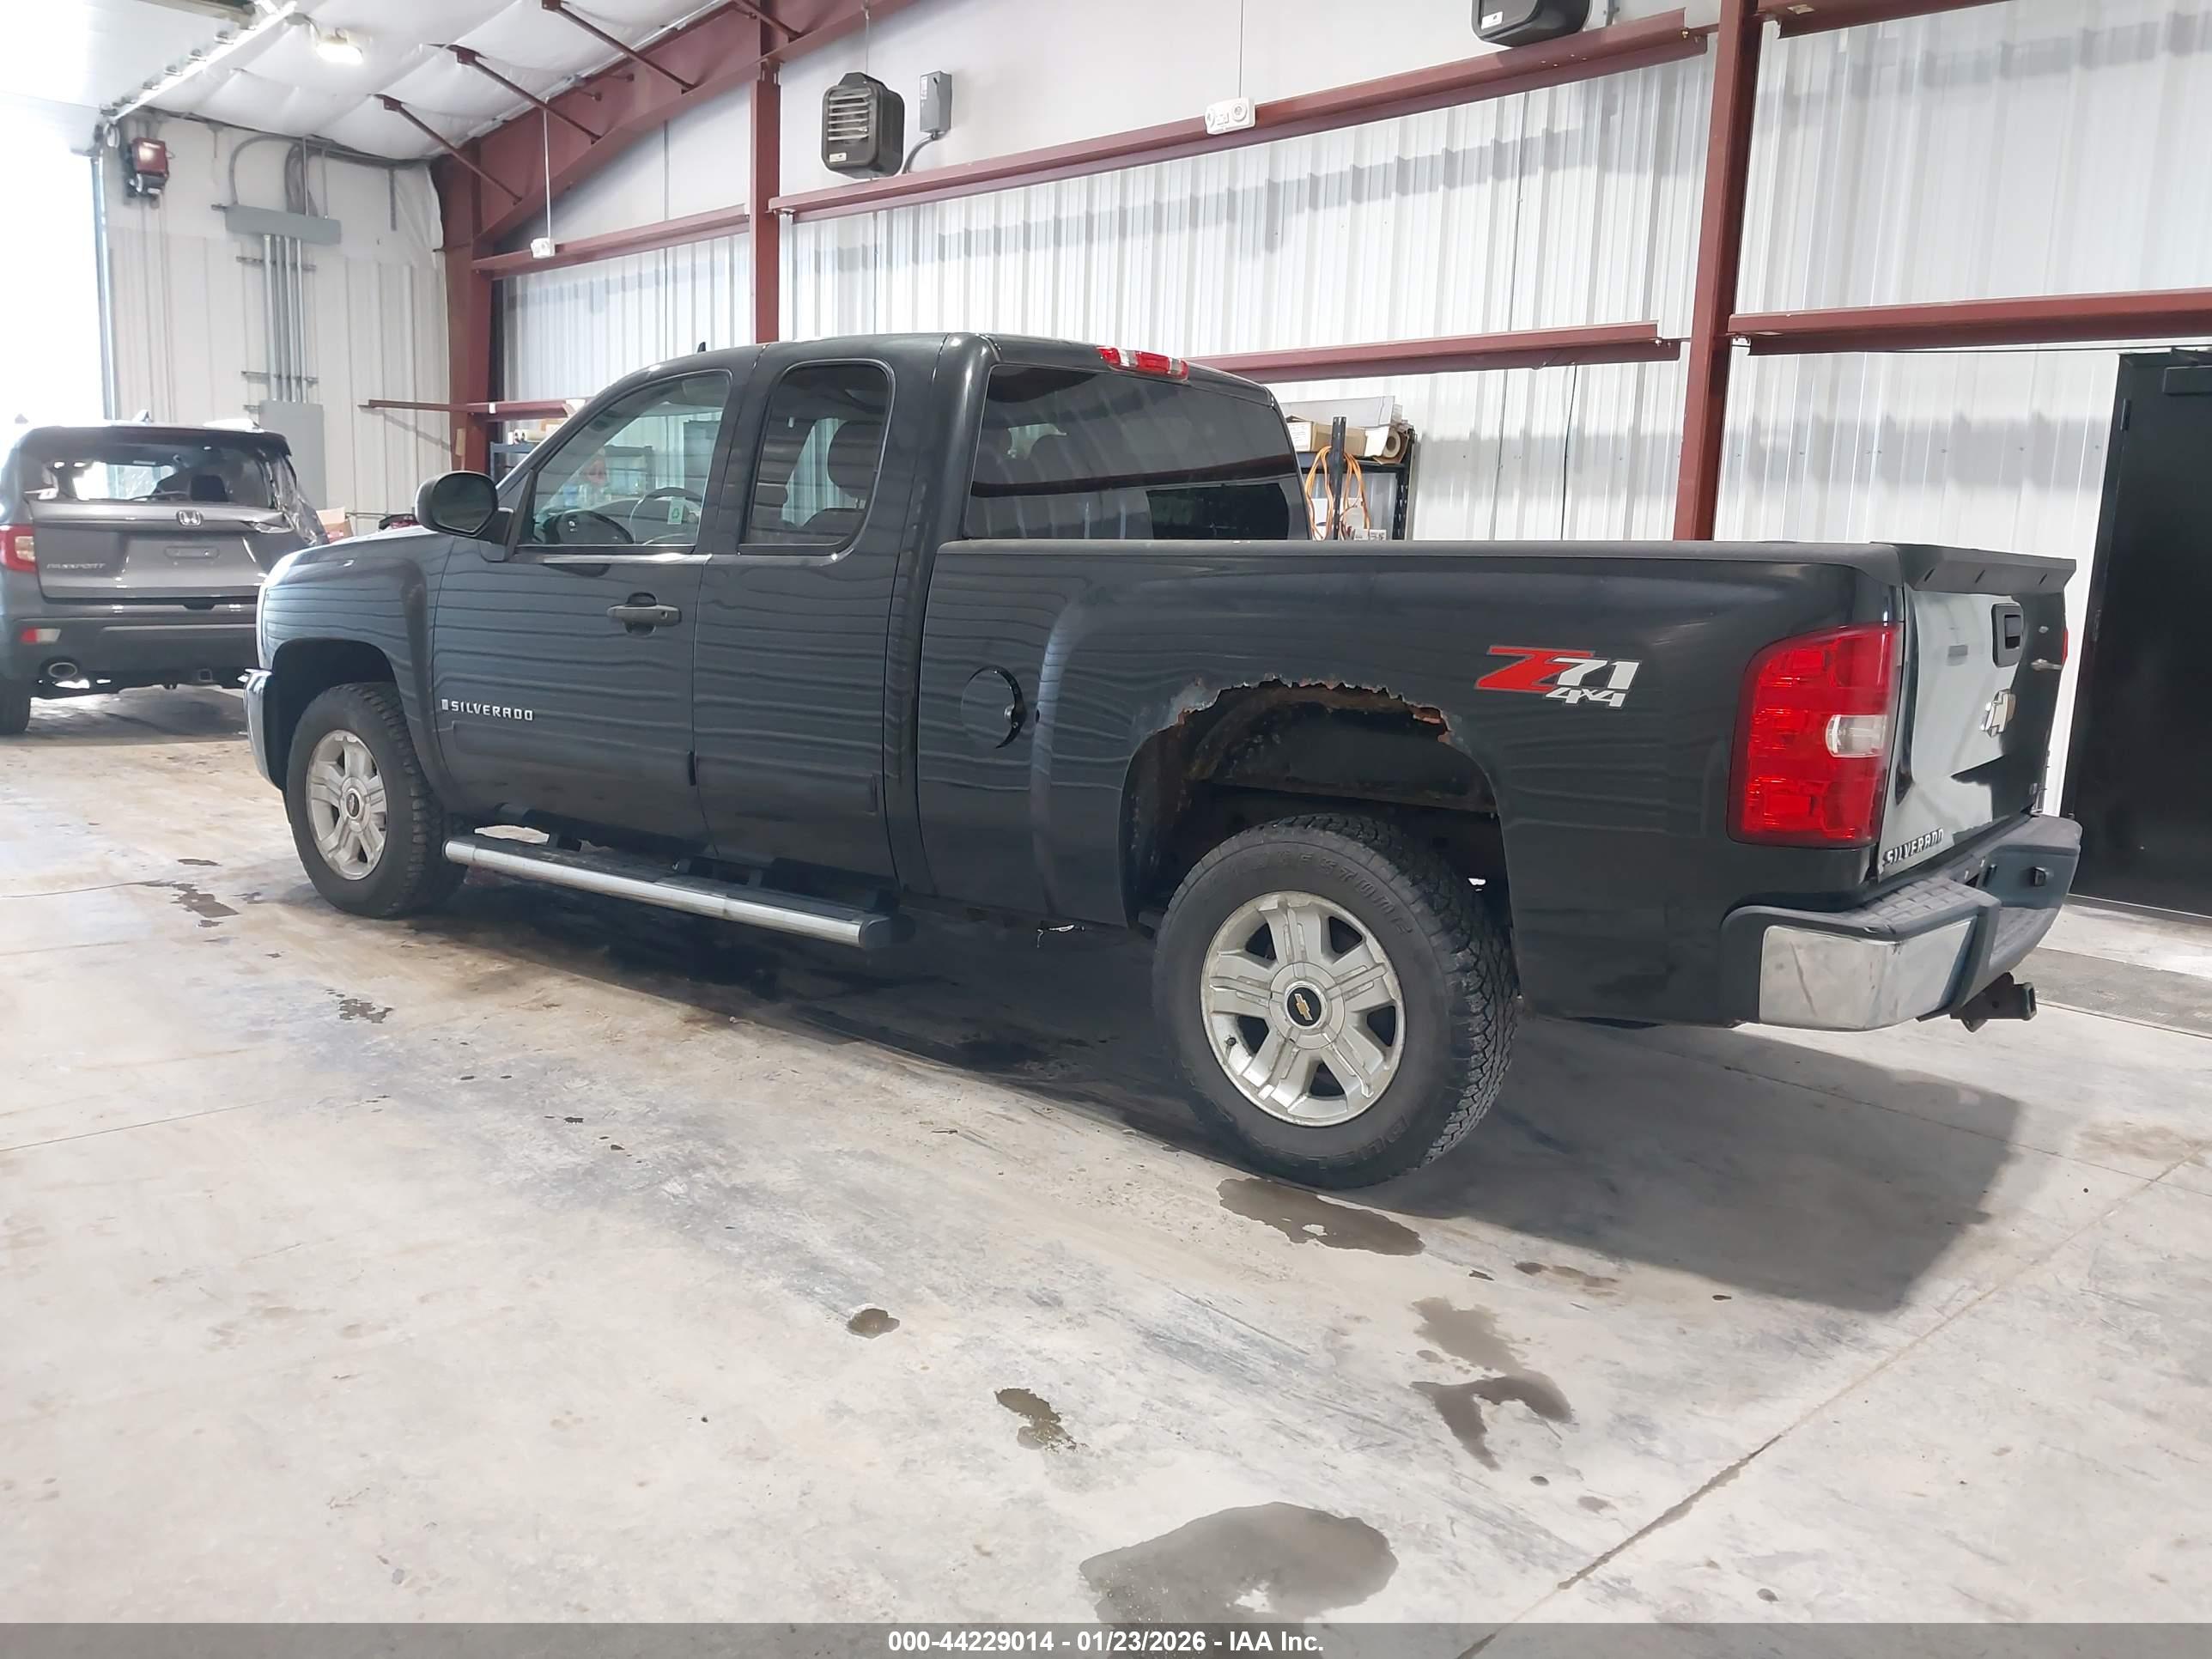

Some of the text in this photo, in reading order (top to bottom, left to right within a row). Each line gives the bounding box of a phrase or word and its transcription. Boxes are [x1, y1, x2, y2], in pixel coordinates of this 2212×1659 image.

[1475, 646, 1641, 694] Z71
[451, 700, 534, 721] SILVERADO
[1887, 828, 1945, 865] SILVERADO
